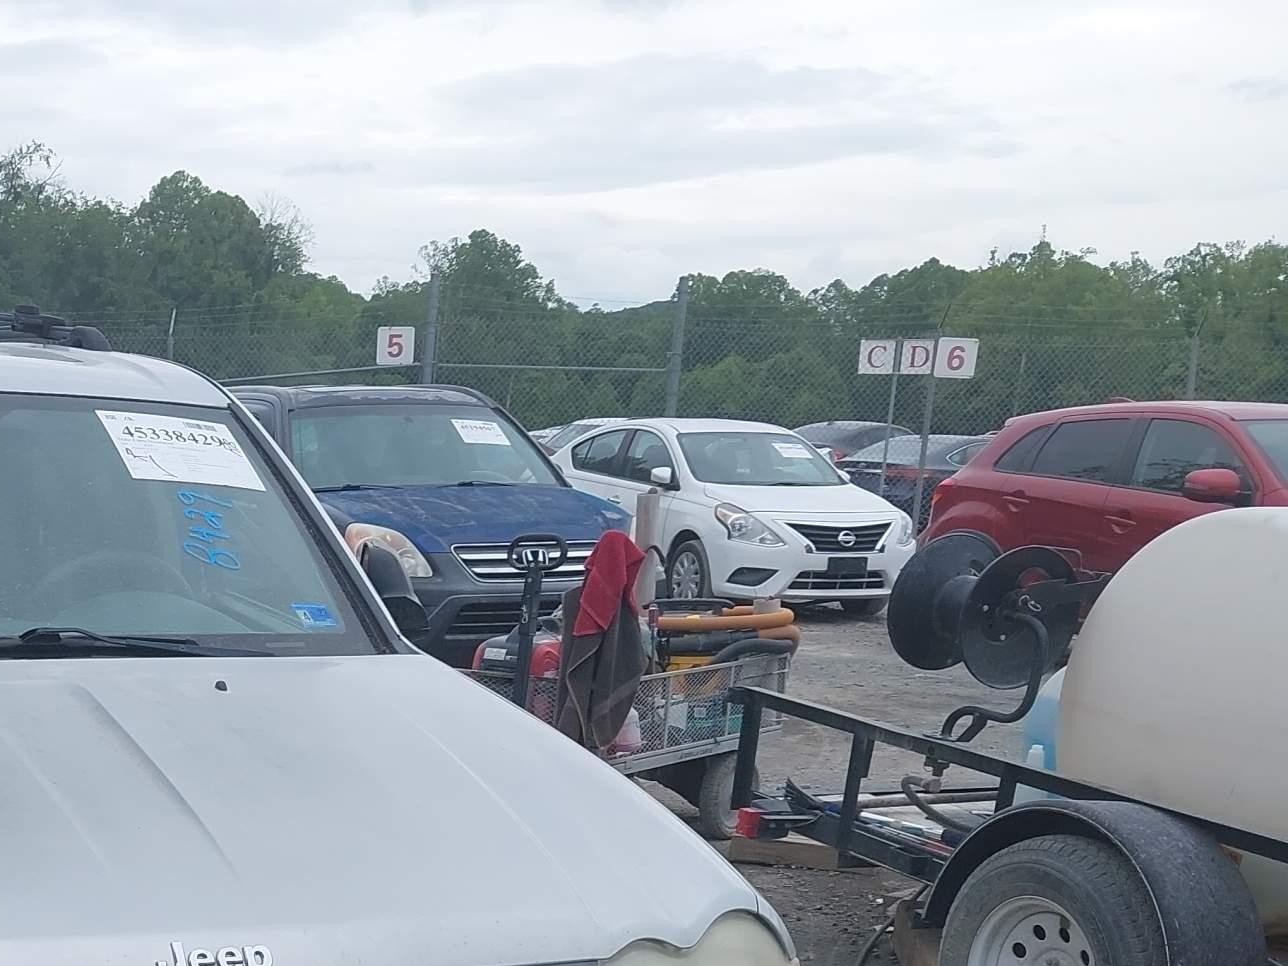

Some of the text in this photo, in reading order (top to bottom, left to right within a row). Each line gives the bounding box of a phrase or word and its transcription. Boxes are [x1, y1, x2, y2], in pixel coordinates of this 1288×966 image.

[387, 334, 403, 358] 5
[867, 345, 887, 368] C
[908, 345, 930, 368] D
[947, 346, 966, 371] 6
[122, 425, 223, 447] 45338429
[178, 489, 240, 570] 8429
